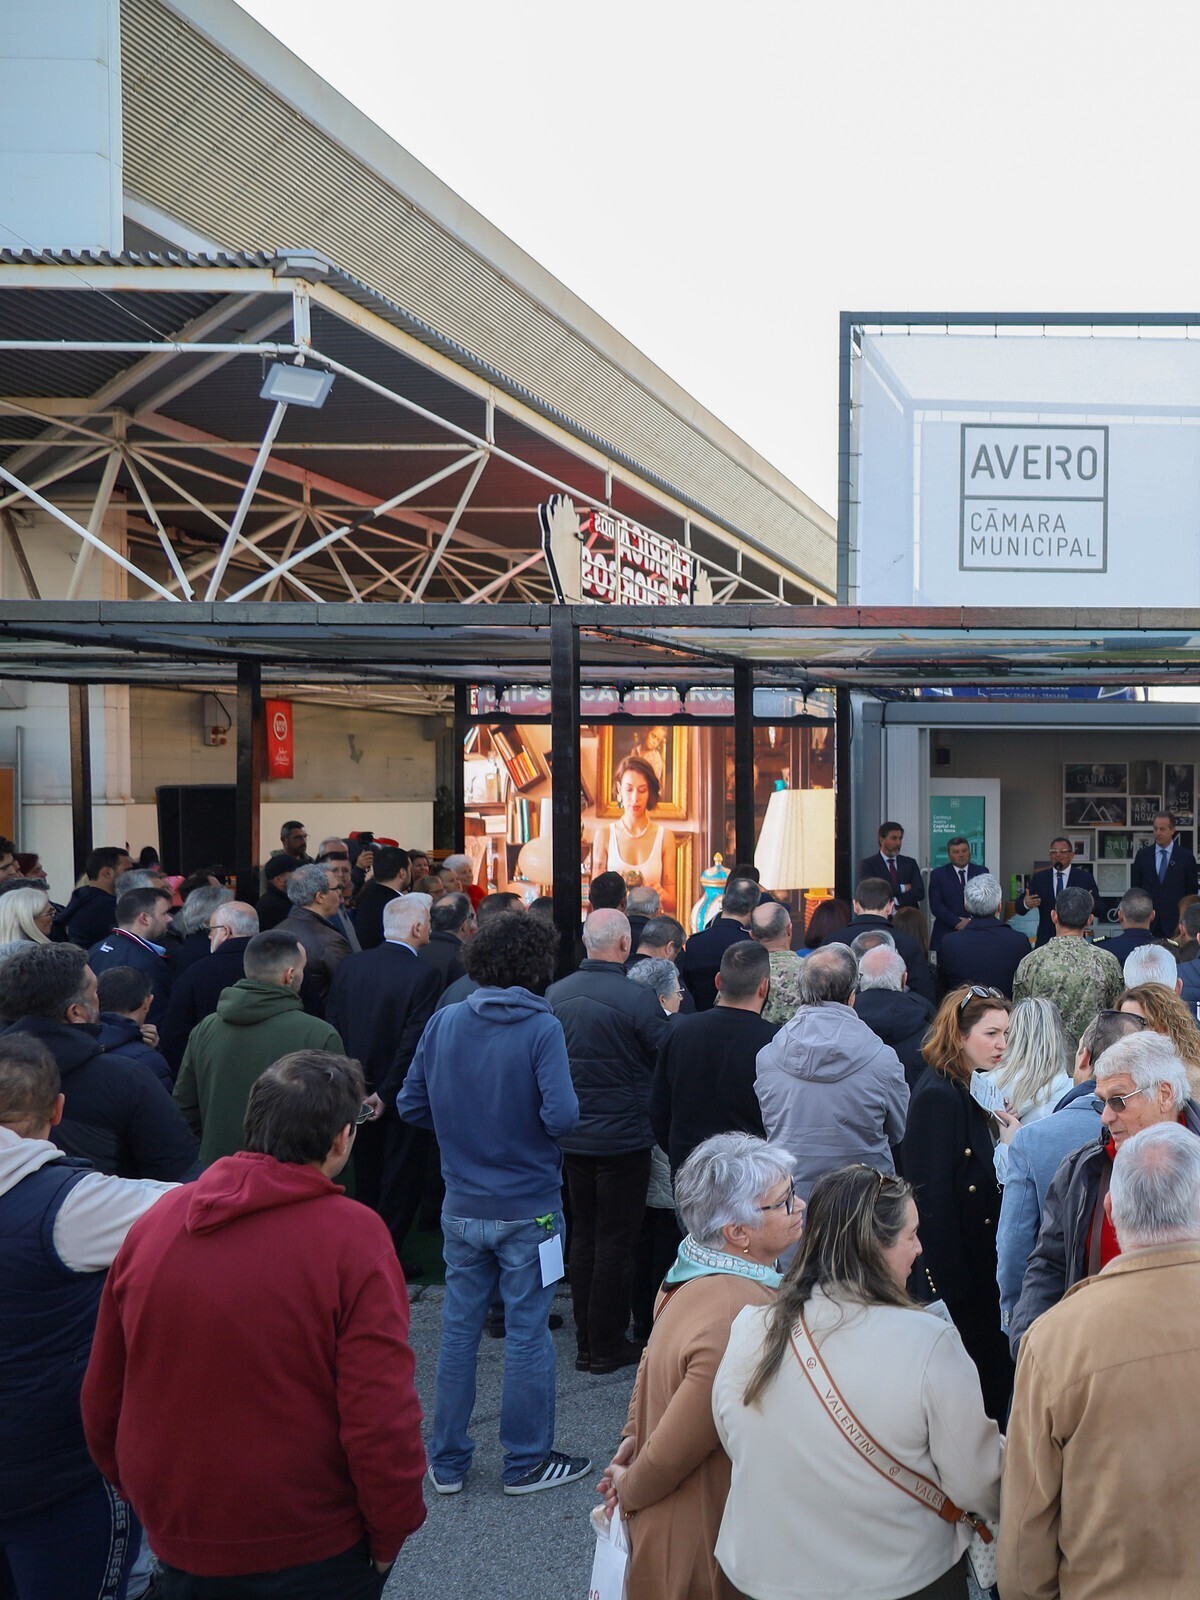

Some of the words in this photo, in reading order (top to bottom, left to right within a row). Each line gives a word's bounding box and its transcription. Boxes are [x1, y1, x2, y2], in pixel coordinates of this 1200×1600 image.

[970, 443, 1098, 481] AVEIRO
[970, 536, 1097, 557] MUNICIPAL
[1077, 774, 1115, 784] CANAIS
[1134, 803, 1157, 813] ARTE
[825, 1389, 877, 1457] VALENTINI
[107, 1538, 124, 1588] GUESS
